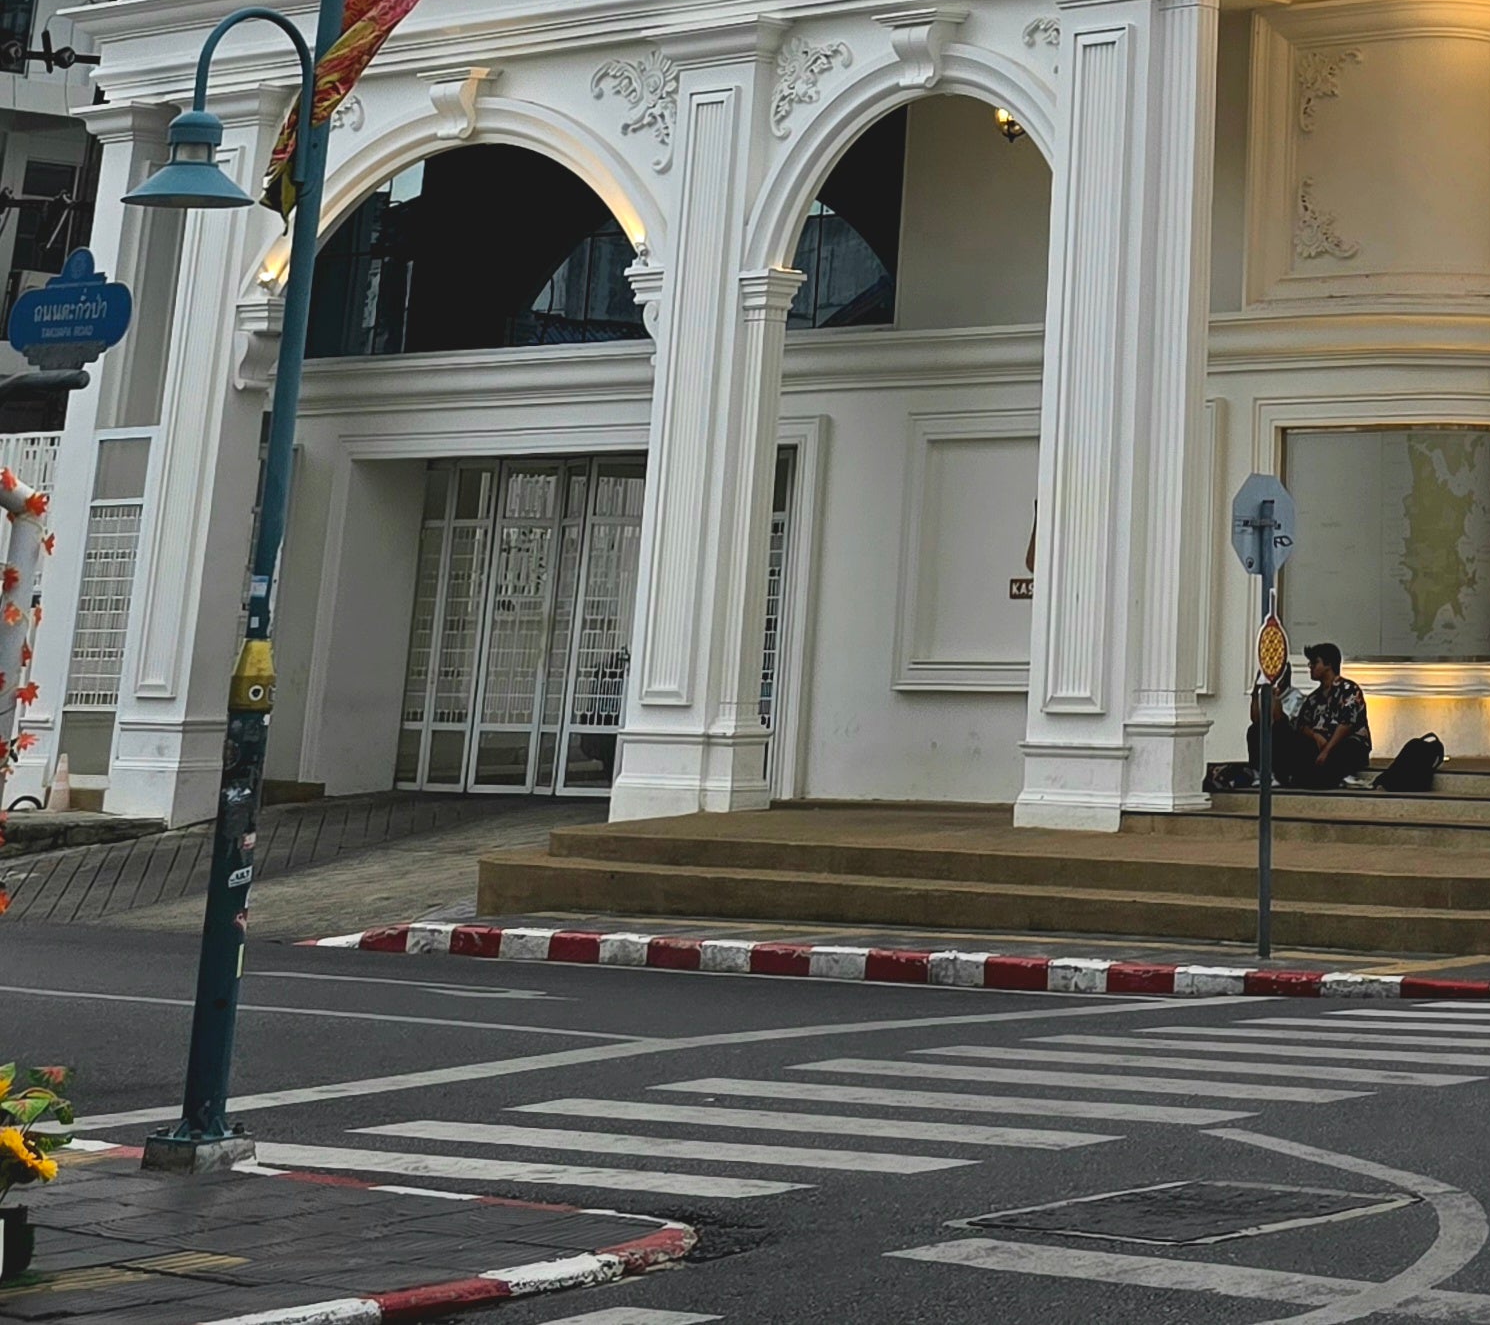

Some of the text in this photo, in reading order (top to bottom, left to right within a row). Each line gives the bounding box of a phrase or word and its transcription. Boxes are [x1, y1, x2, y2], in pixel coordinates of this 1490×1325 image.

[34, 287, 108, 323] ถนนตะกั่วป่า
